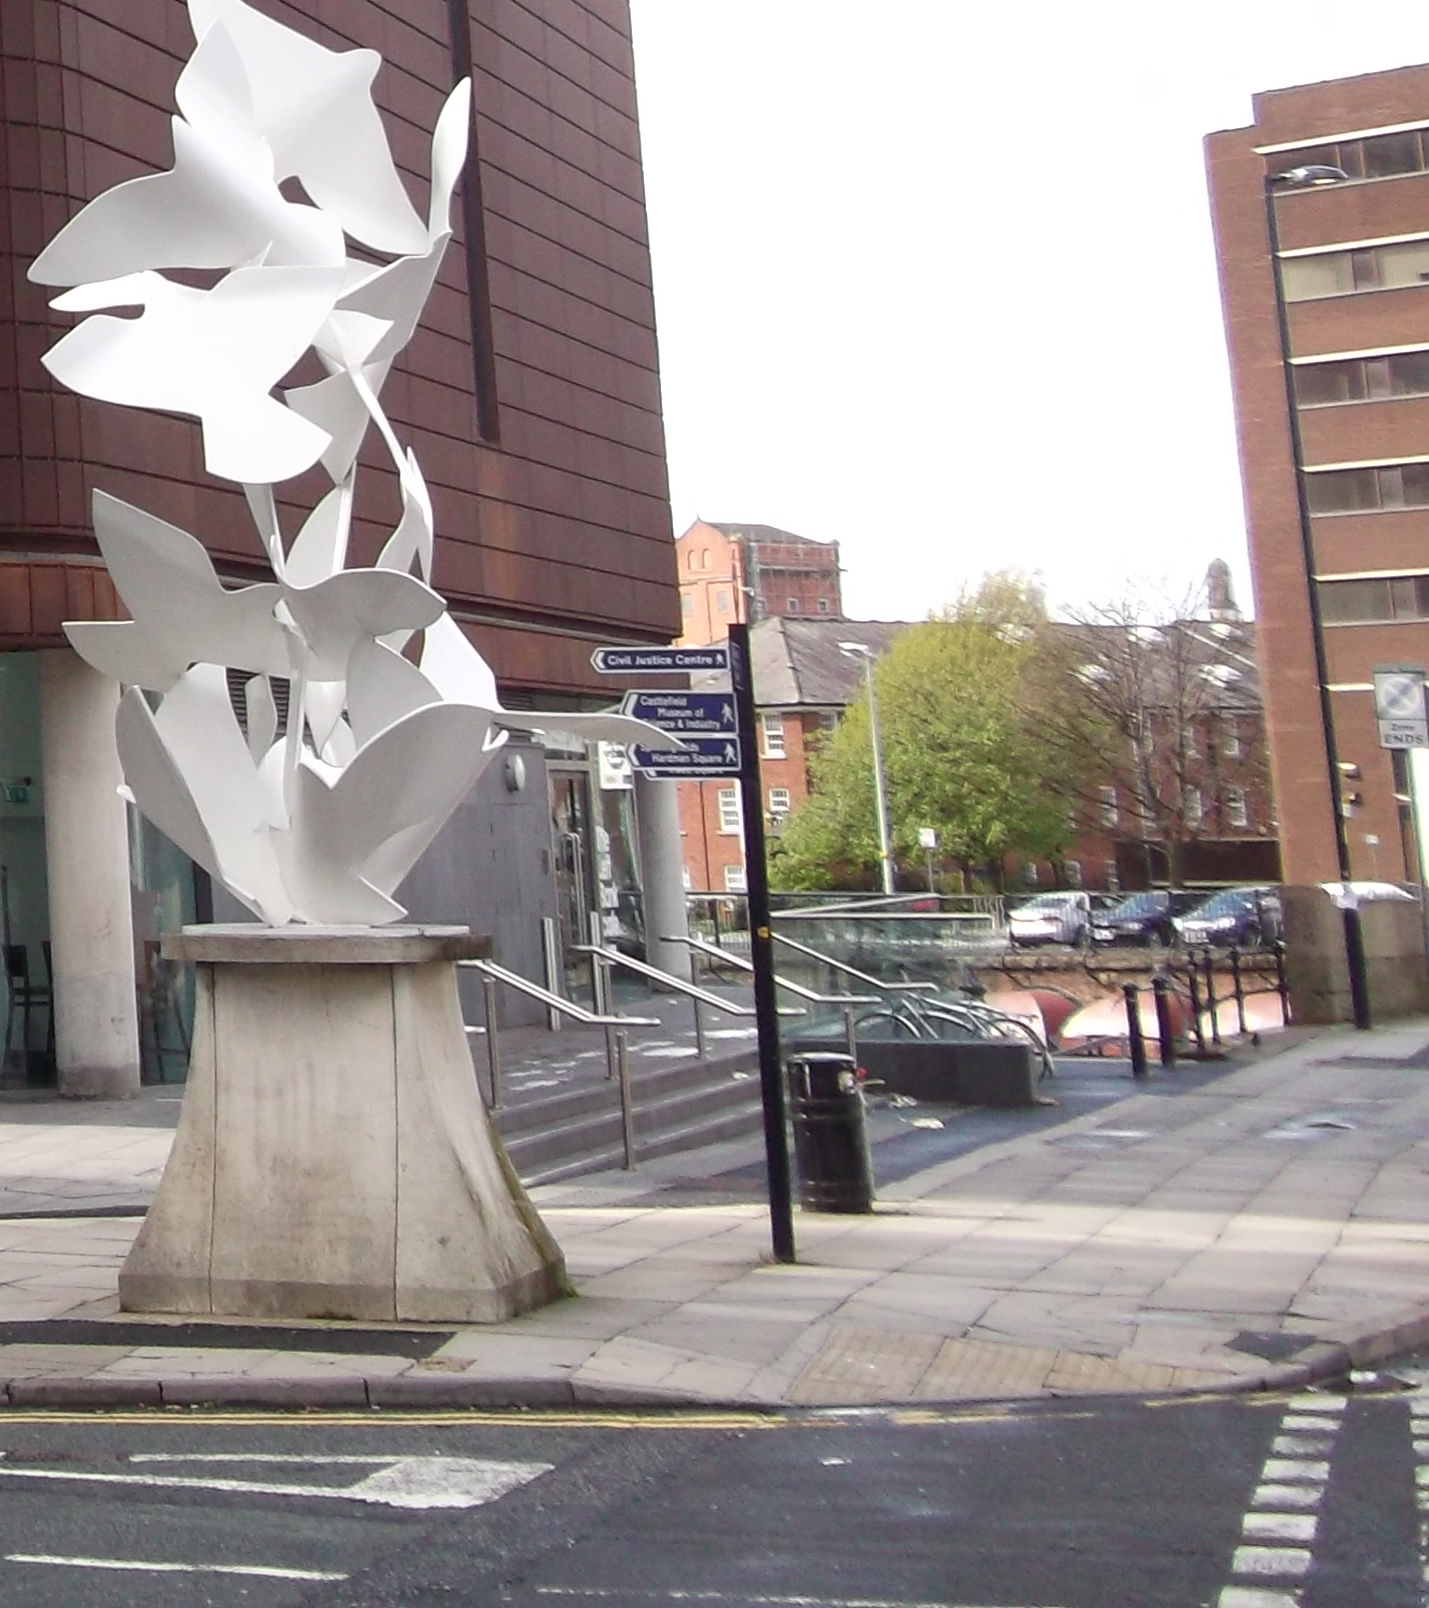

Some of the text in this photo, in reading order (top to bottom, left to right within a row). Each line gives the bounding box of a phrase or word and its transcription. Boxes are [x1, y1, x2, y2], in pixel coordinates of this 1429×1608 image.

[607, 654, 714, 666] Civil Justice Centre
[640, 695, 687, 706] Castlefield
[657, 707, 704, 717] Museum of
[686, 718, 721, 730] Industry
[1384, 734, 1424, 745] ENDS
[652, 752, 723, 765] Hardman Square
